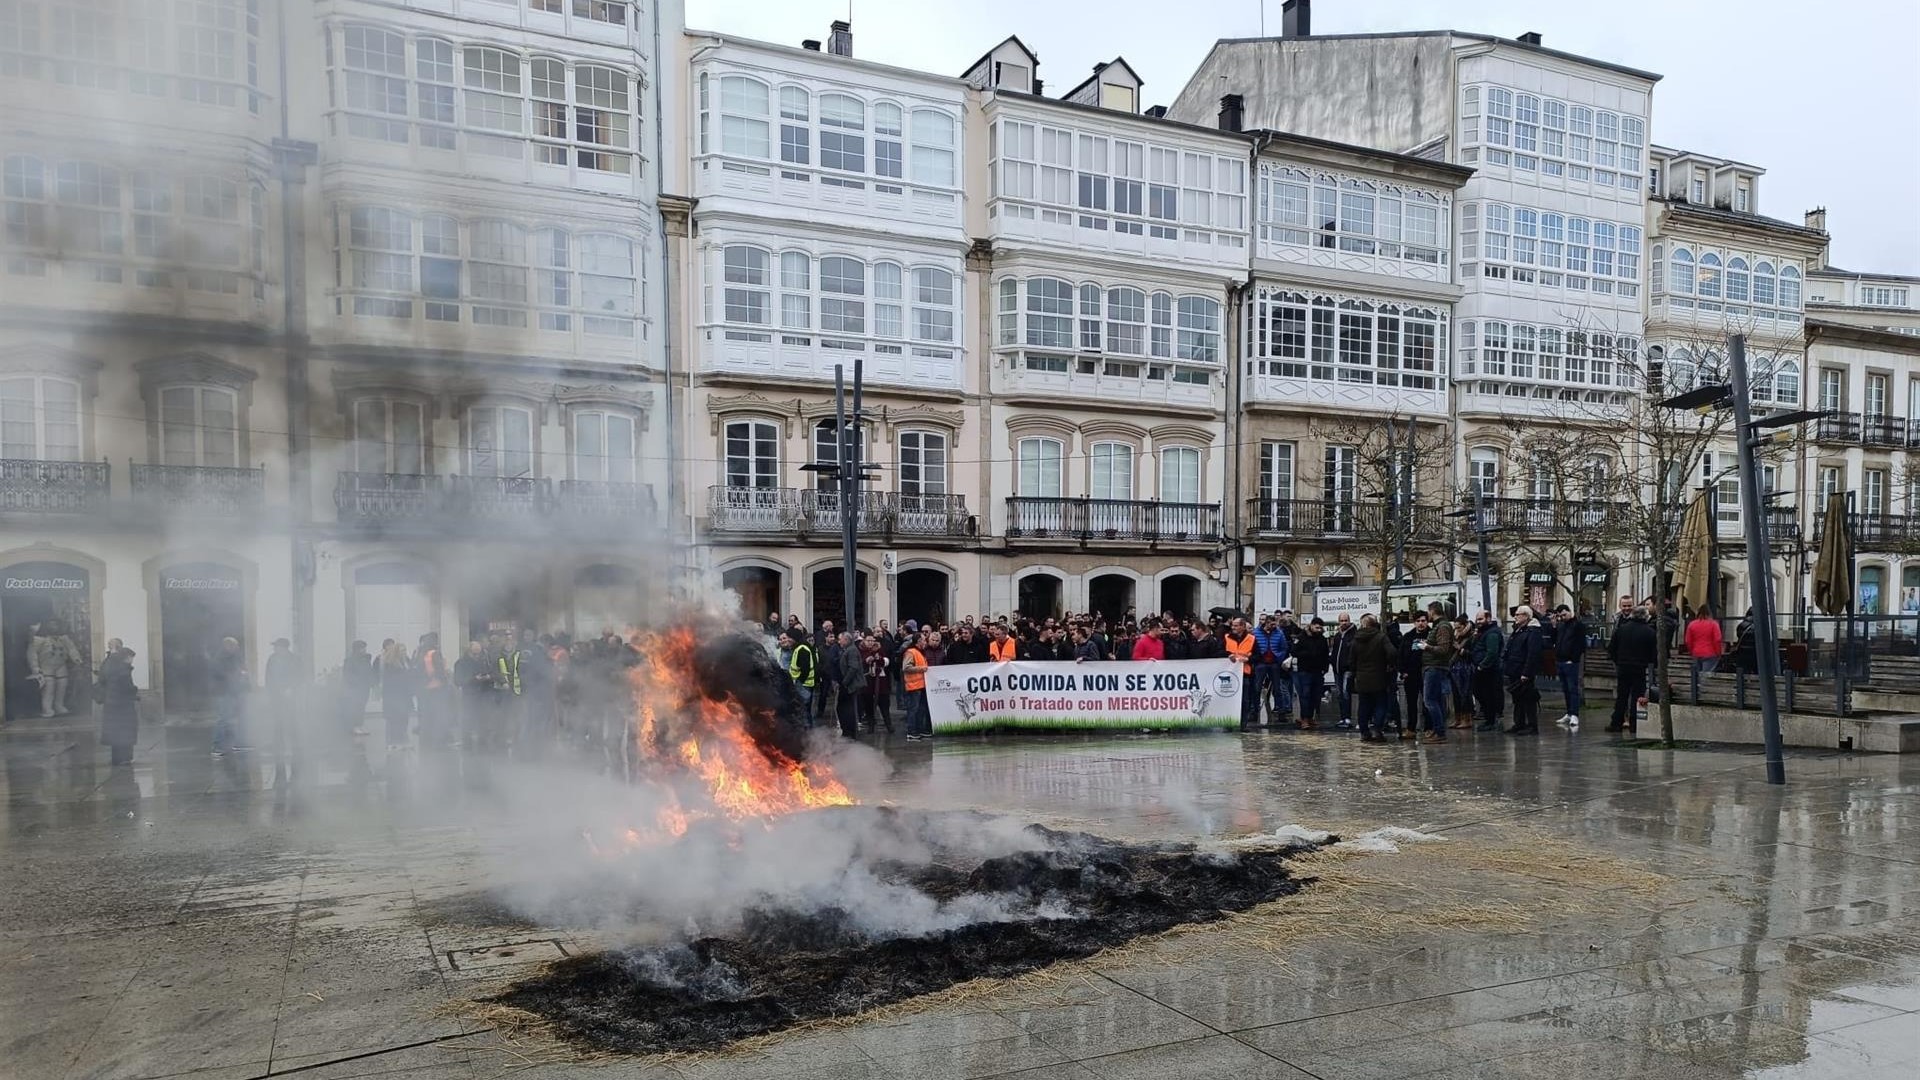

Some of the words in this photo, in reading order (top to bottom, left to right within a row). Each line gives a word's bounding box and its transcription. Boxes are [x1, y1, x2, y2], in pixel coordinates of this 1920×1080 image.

[5, 578, 33, 589] Foot
[34, 579, 51, 589] on
[51, 578, 84, 589] Mars
[967, 675, 1002, 694] COA
[1007, 674, 1077, 691] COMIDA
[1083, 674, 1119, 691] NON
[1125, 674, 1146, 691] SE
[1153, 673, 1200, 691] XOGA
[980, 698, 1004, 711] Non
[1019, 697, 1073, 711] Tratado
[1078, 699, 1102, 711] con
[1107, 697, 1189, 711] MERCOSUR
